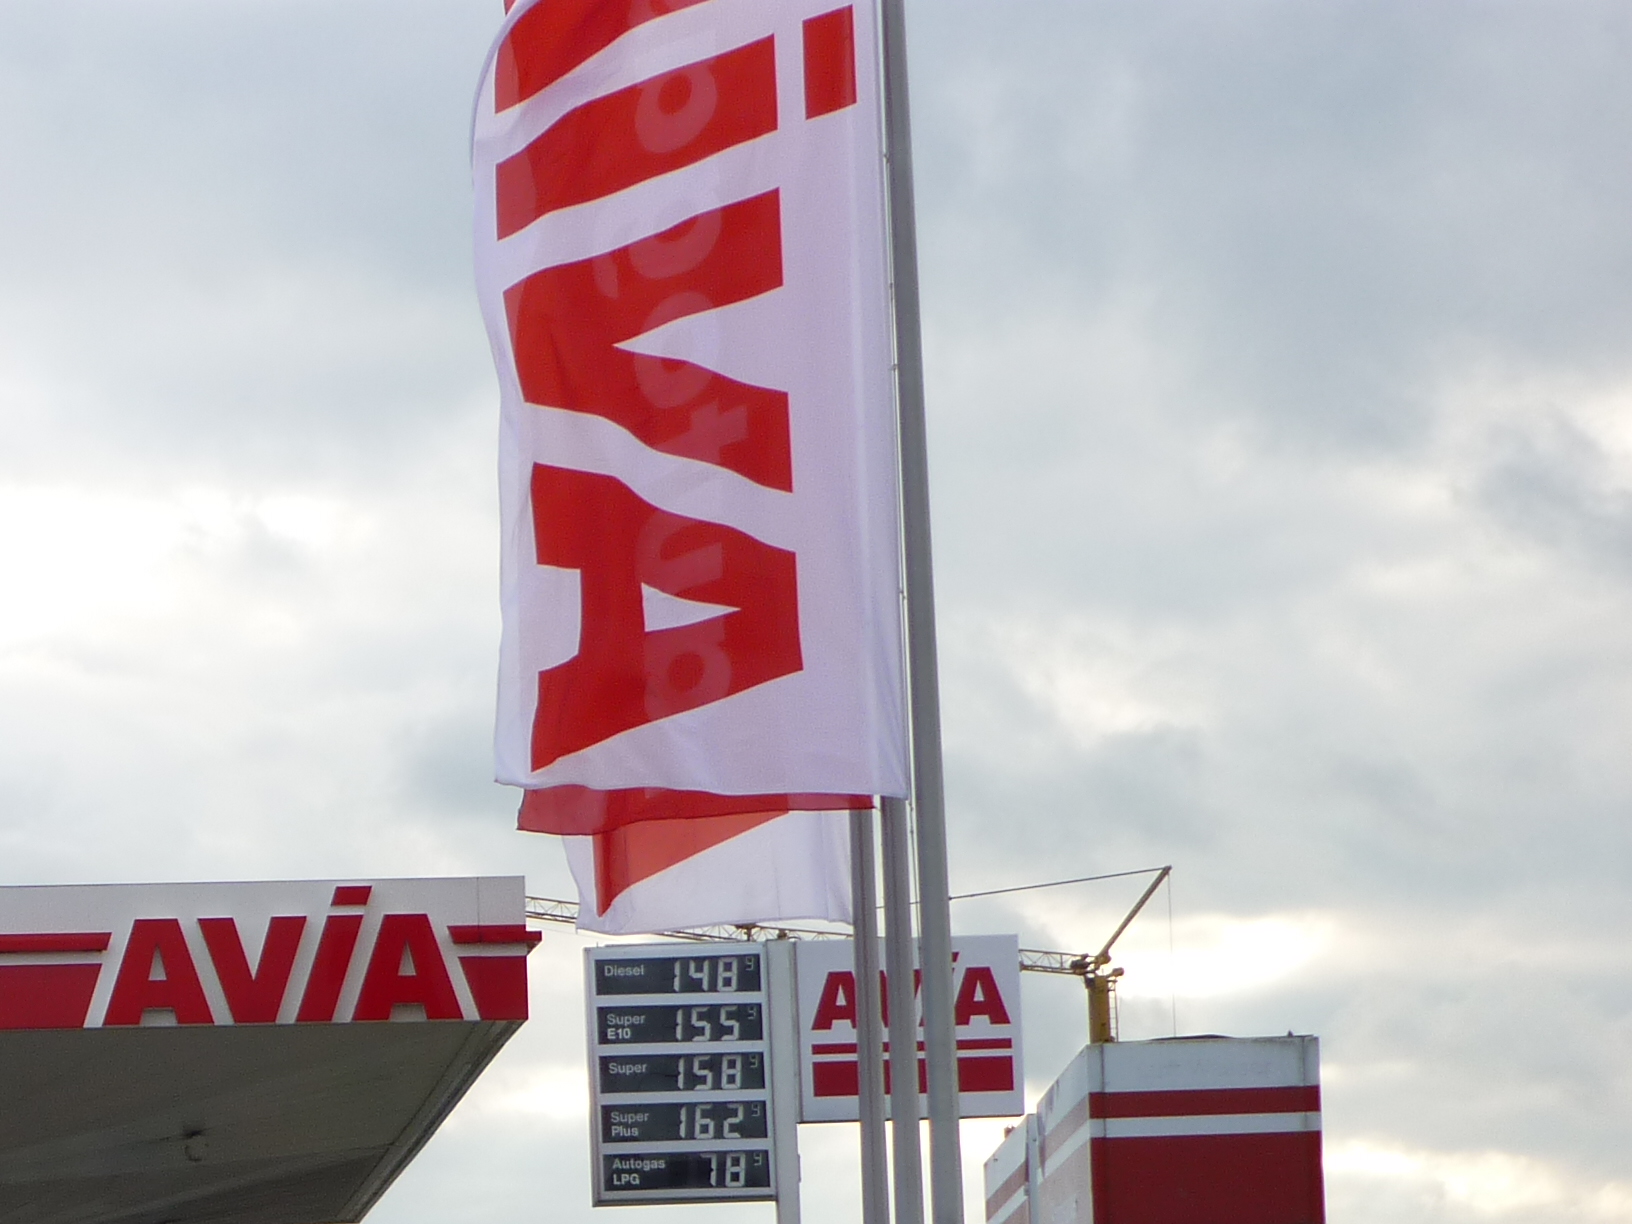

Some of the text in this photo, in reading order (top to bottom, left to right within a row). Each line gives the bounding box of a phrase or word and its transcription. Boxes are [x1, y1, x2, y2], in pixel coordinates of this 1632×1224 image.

[604, 965, 644, 976] Diesel
[606, 1014, 646, 1026] Super
[607, 1028, 631, 1040] E10
[608, 1063, 647, 1075] Super
[610, 1112, 649, 1124] Super
[612, 1126, 638, 1136] Plus
[612, 1158, 666, 1171] Autogas
[613, 1174, 640, 1185] LPG
